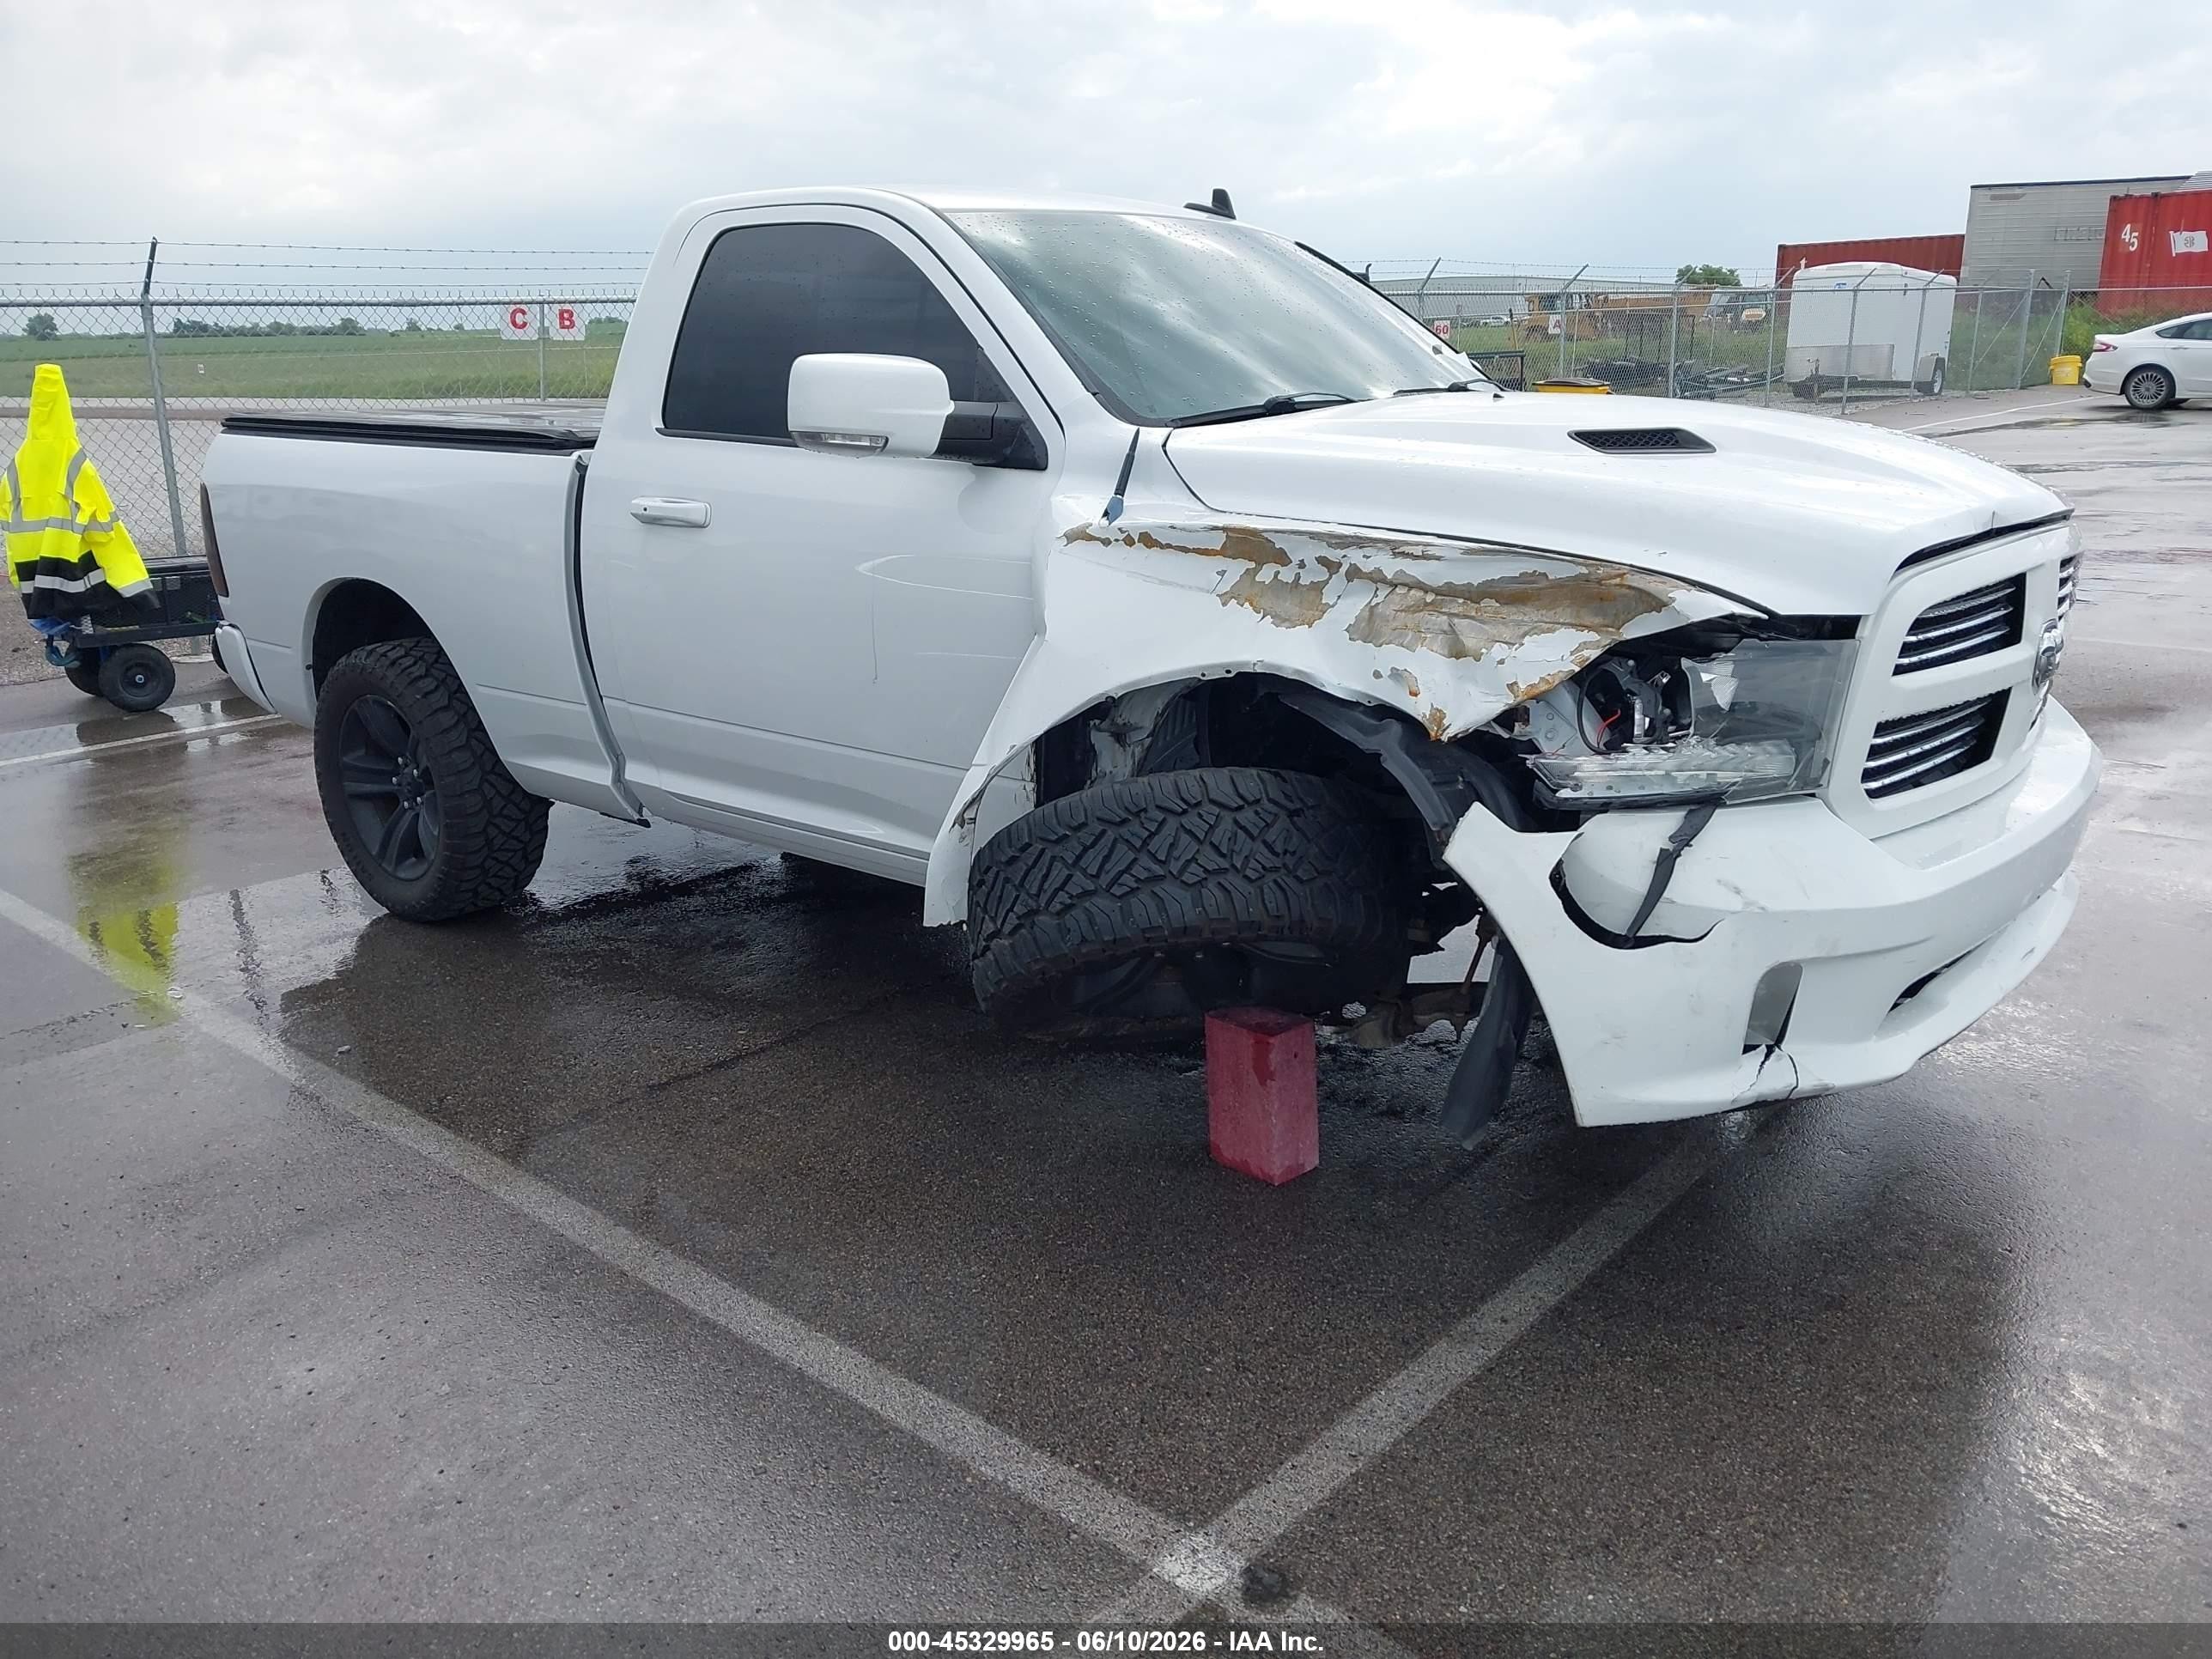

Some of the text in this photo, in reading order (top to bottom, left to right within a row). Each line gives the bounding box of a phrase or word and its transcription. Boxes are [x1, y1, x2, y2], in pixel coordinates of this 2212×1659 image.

[2121, 223, 2139, 252] 45
[509, 307, 529, 330] C
[558, 308, 575, 329] B
[1435, 325, 1449, 335] 60
